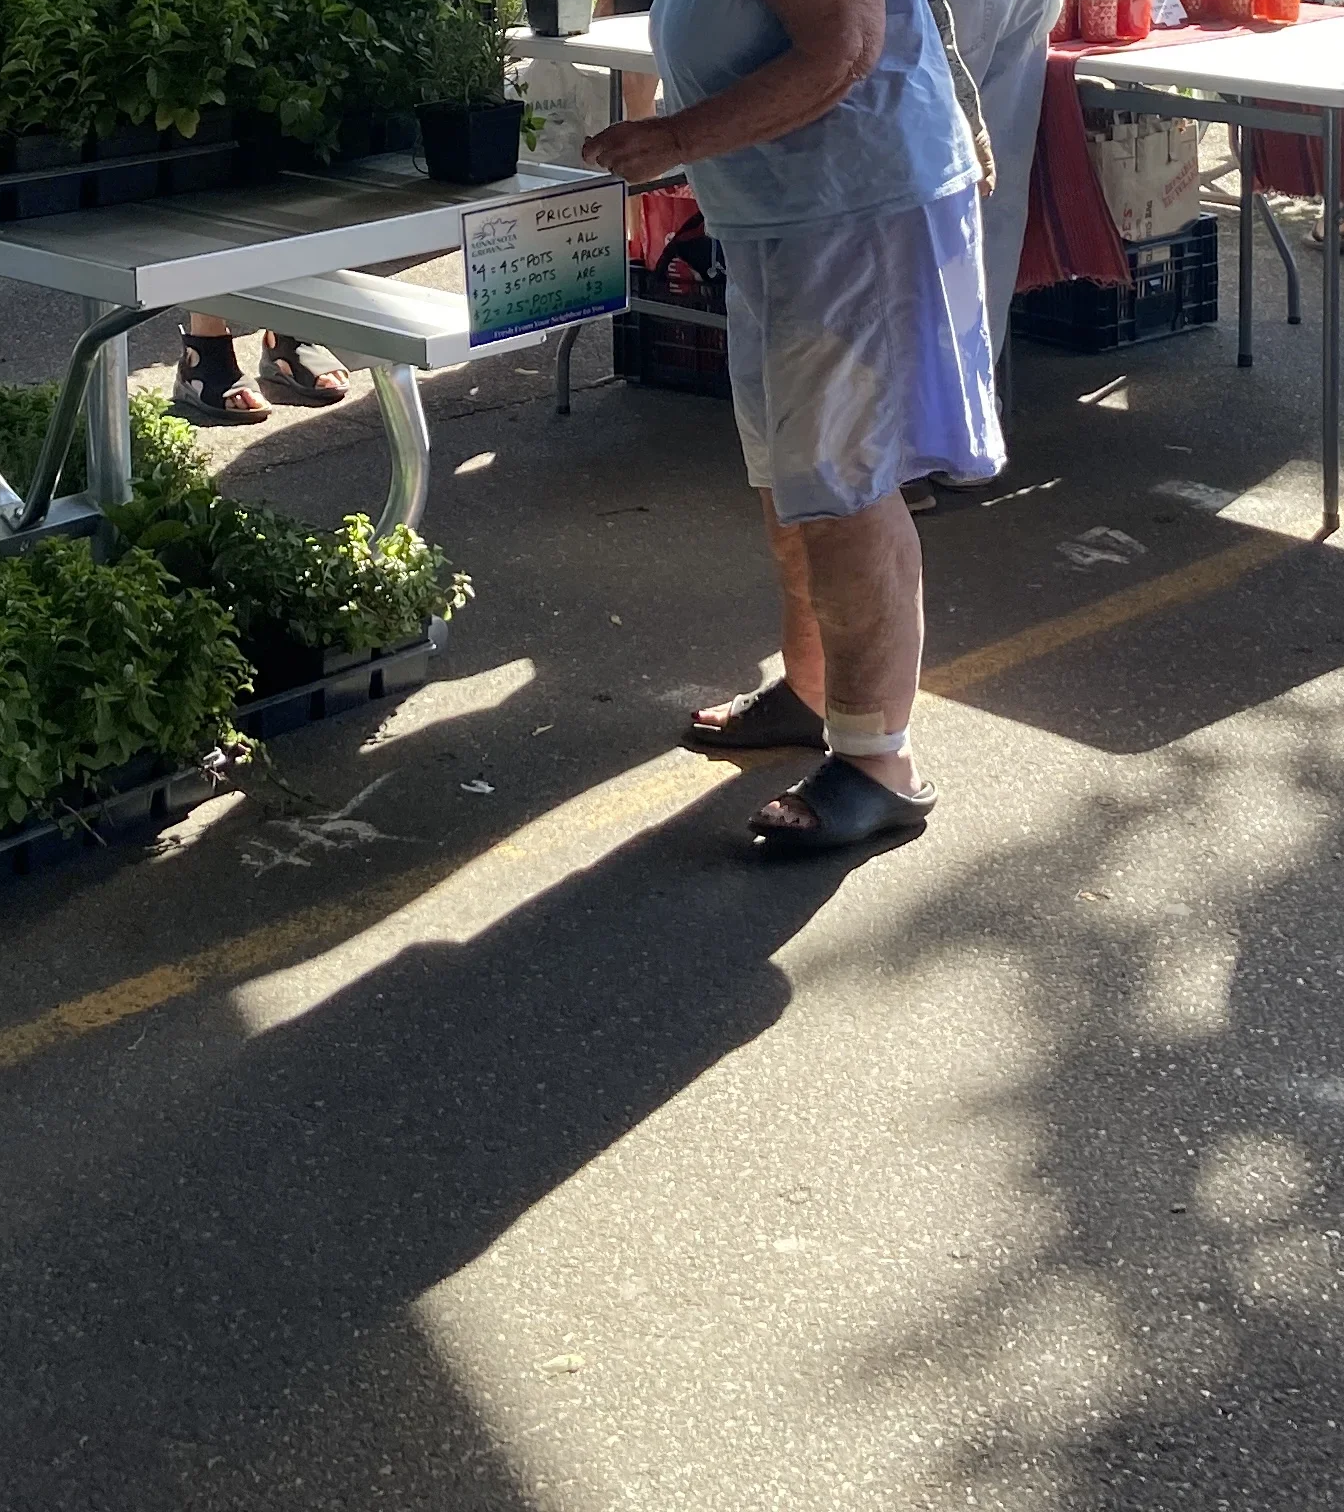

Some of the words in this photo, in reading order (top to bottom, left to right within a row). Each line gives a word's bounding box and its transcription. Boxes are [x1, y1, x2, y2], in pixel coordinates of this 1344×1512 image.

[536, 201, 602, 225] PRICING
[471, 233, 518, 249] MINNESOTA
[577, 231, 599, 245] ALL
[526, 250, 554, 269] POTS
[576, 265, 596, 281] ARE
[473, 288, 490, 307] $3
[528, 268, 557, 286] POTS
[585, 280, 604, 296] $3
[473, 308, 493, 325] $2
[532, 289, 563, 307] POTS
[493, 326, 514, 339] Fresh
[515, 323, 533, 335] From
